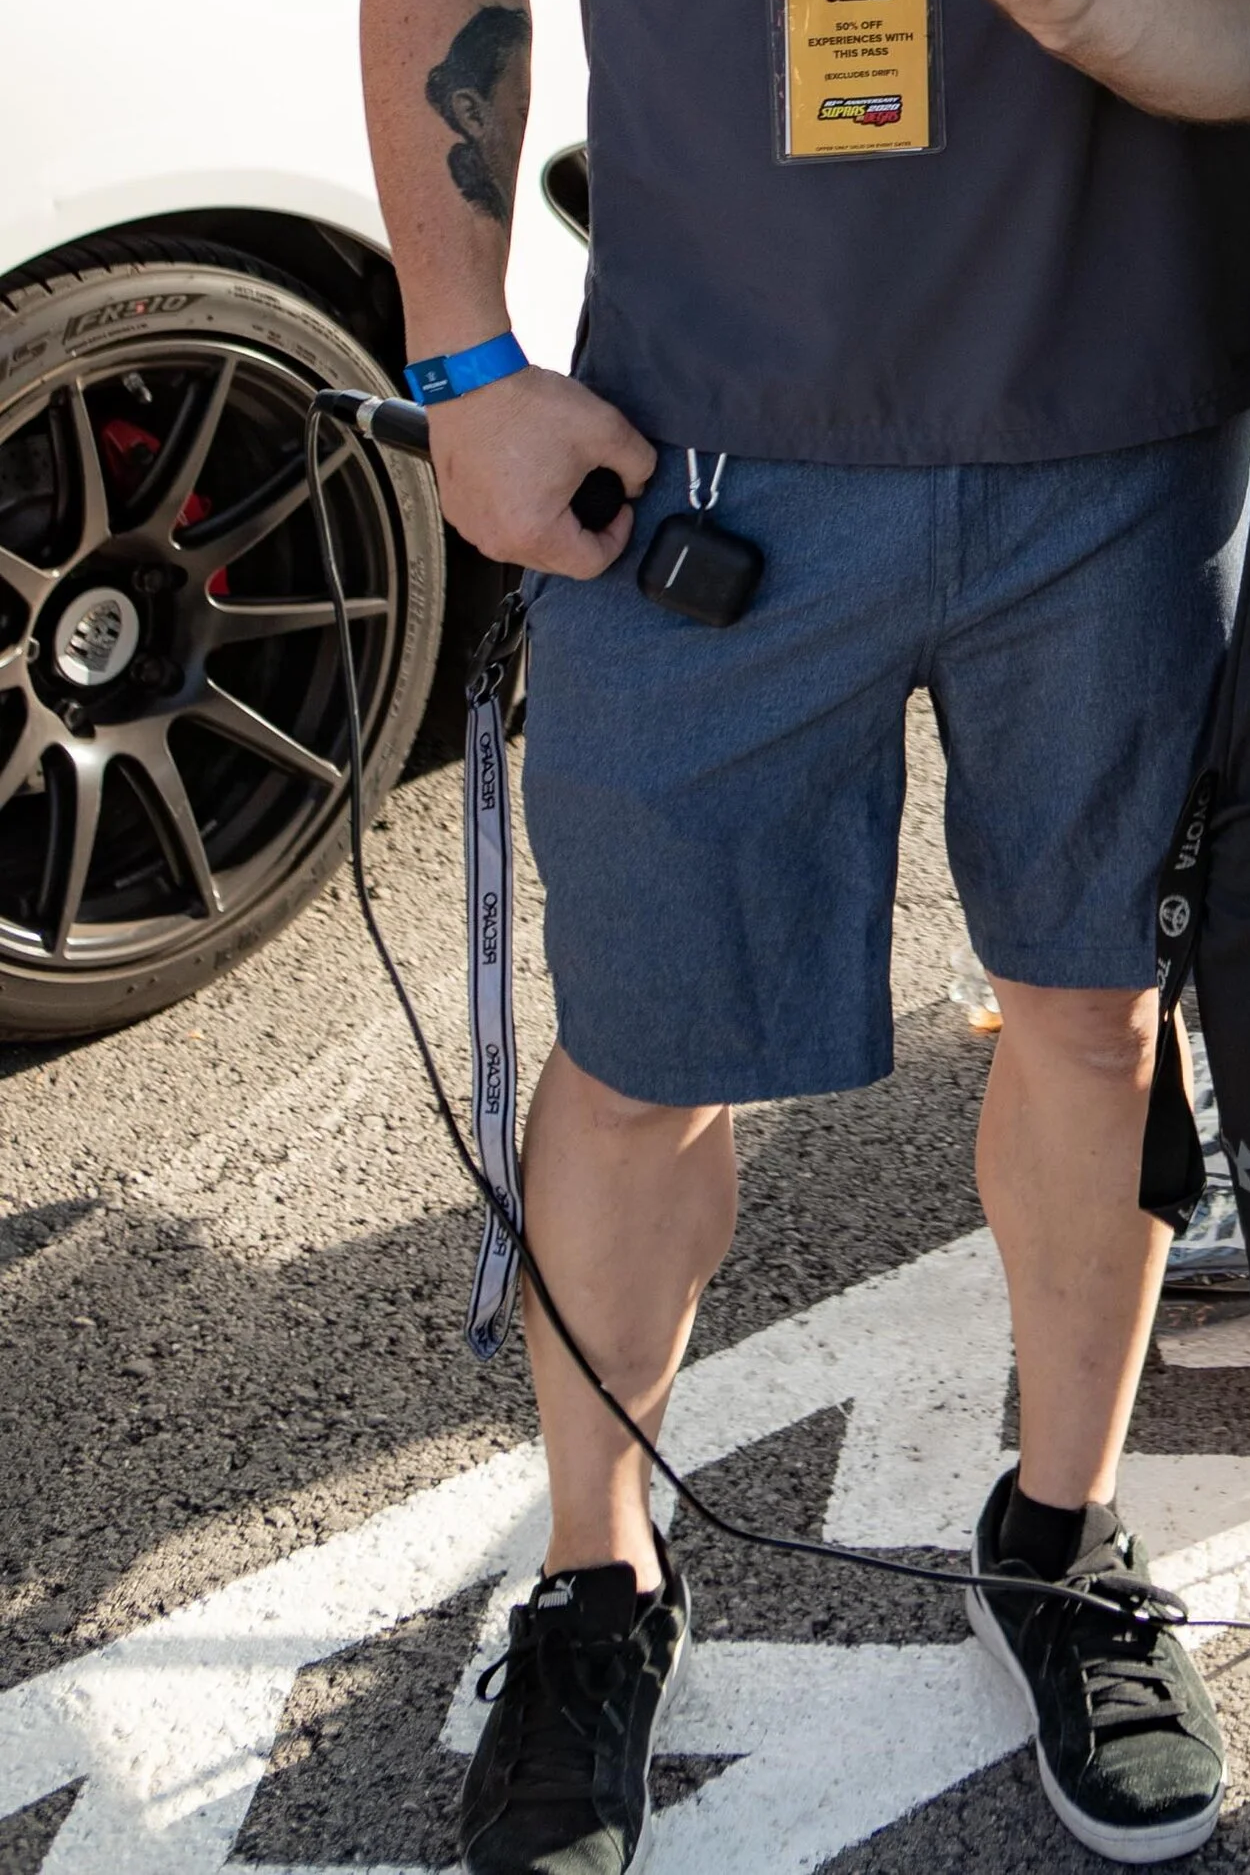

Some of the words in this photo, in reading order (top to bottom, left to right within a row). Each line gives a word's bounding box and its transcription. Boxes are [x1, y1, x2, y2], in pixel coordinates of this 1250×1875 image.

[835, 21, 858, 32] 50%
[861, 20, 883, 30] OFF
[808, 34, 882, 47] EXPERIENCES
[885, 32, 914, 42] WITH
[834, 49, 858, 59] THIS
[861, 47, 889, 58] PASS
[825, 70, 870, 82] (EXCLUDES
[871, 68, 898, 78] DRIFT)
[820, 105, 866, 118] SUPRAS
[76, 294, 188, 331] FK510
